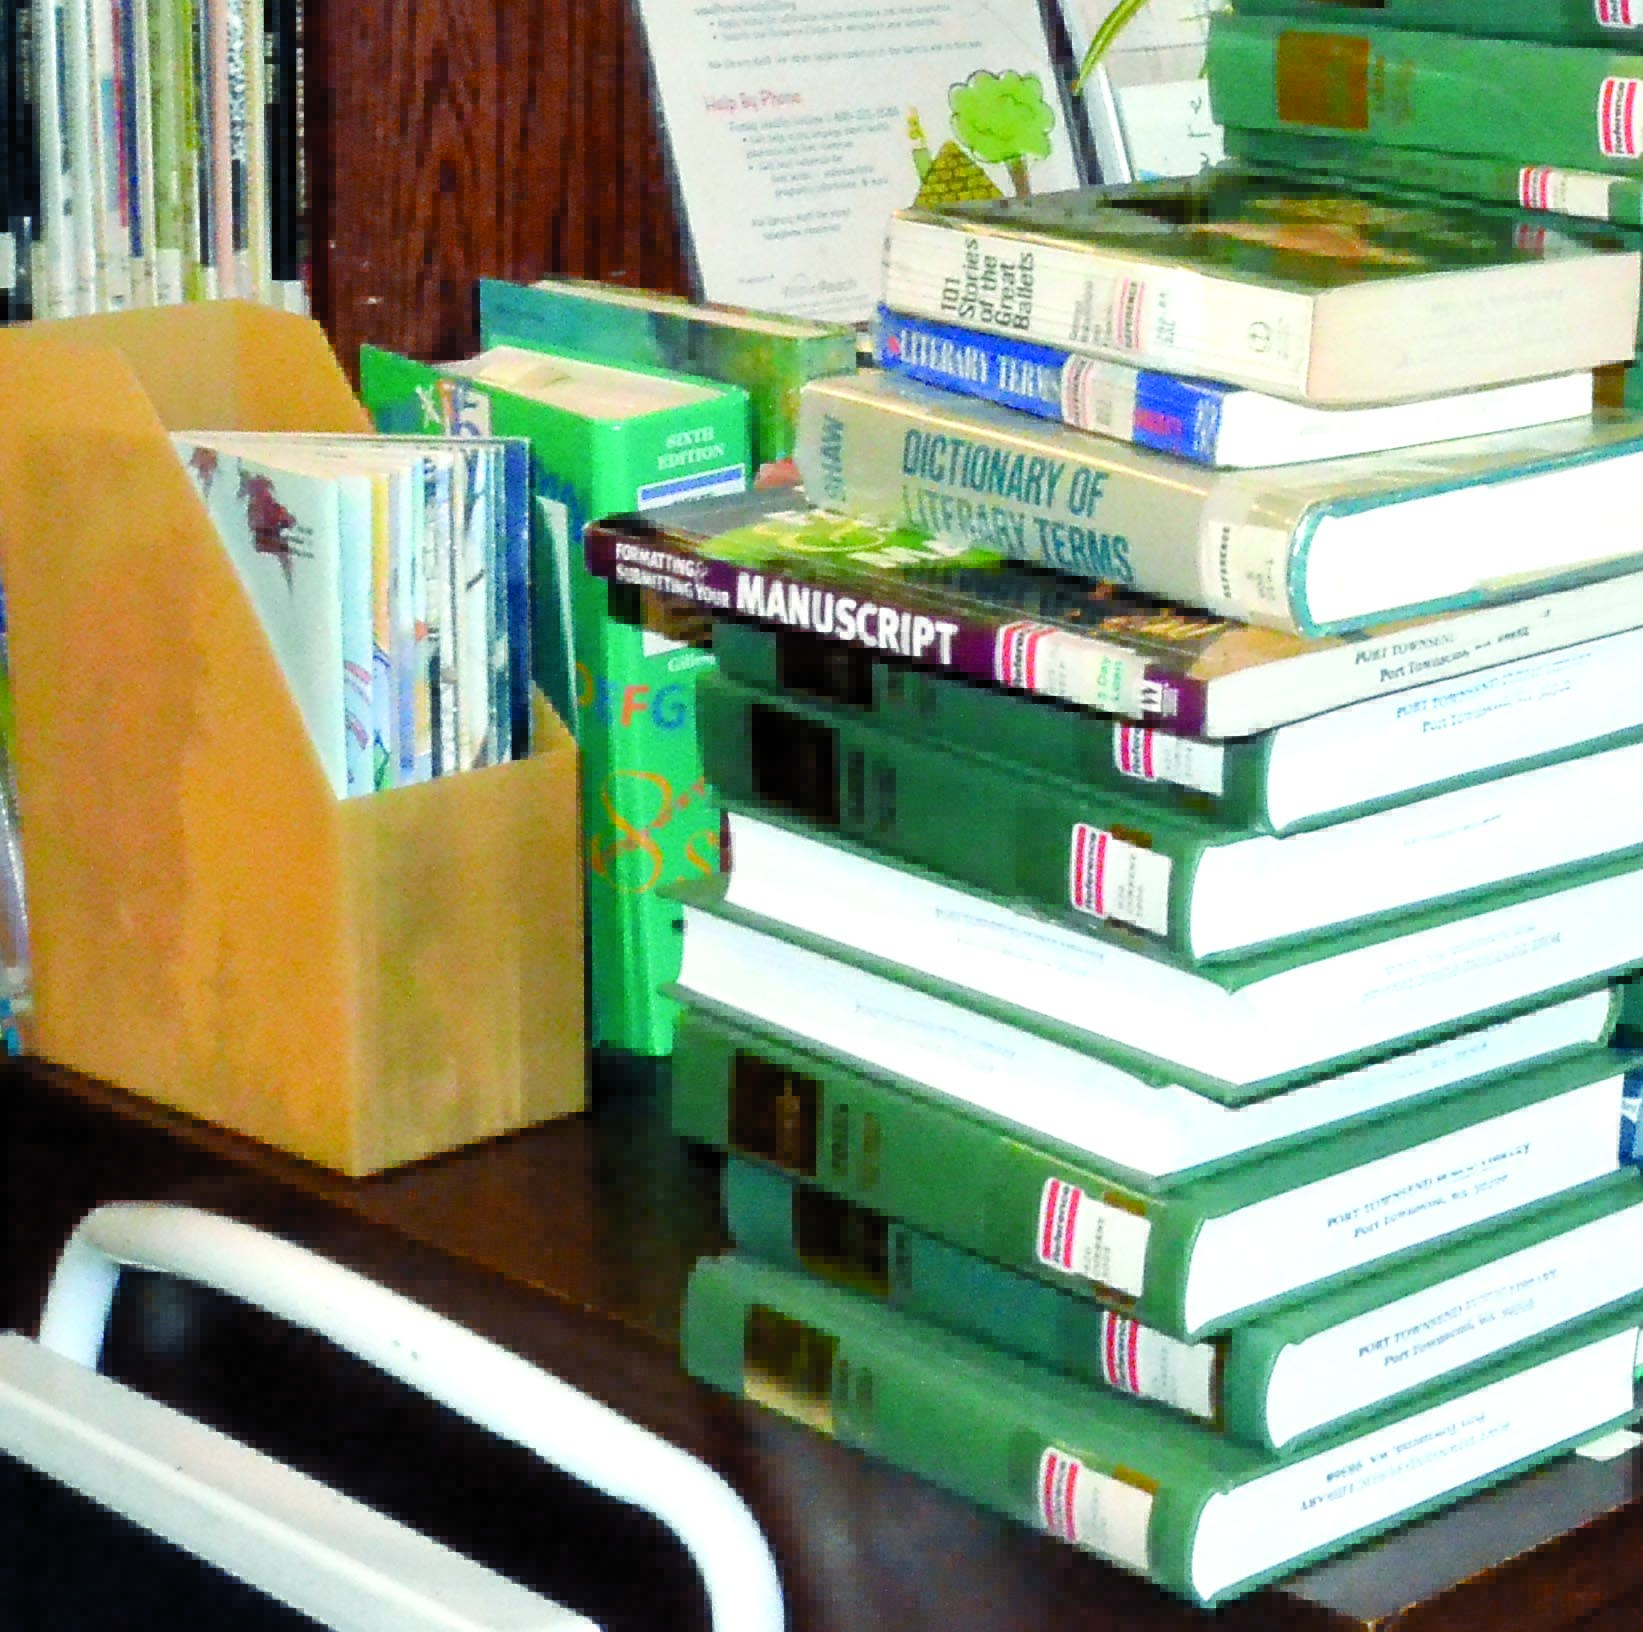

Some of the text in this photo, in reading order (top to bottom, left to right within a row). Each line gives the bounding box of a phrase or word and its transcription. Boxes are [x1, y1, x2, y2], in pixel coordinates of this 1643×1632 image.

[1612, 80, 1626, 154] Reference
[941, 276, 961, 311] 101
[957, 237, 981, 319] Stories
[979, 254, 998, 323] of the
[995, 261, 1017, 327] Great
[1012, 251, 1036, 331] Ballets
[900, 329, 988, 385] LITERARY
[657, 442, 725, 471] EDITION
[665, 426, 715, 449] SIXTH
[901, 427, 1110, 520] DICTIONARY OF
[615, 542, 696, 577] FORMATTING
[1032, 517, 1135, 582] TERMS
[615, 563, 730, 609] SUBMITTING YOUR
[736, 571, 958, 666] MANUSCRIPT
[1054, 1184, 1070, 1265] Reference
